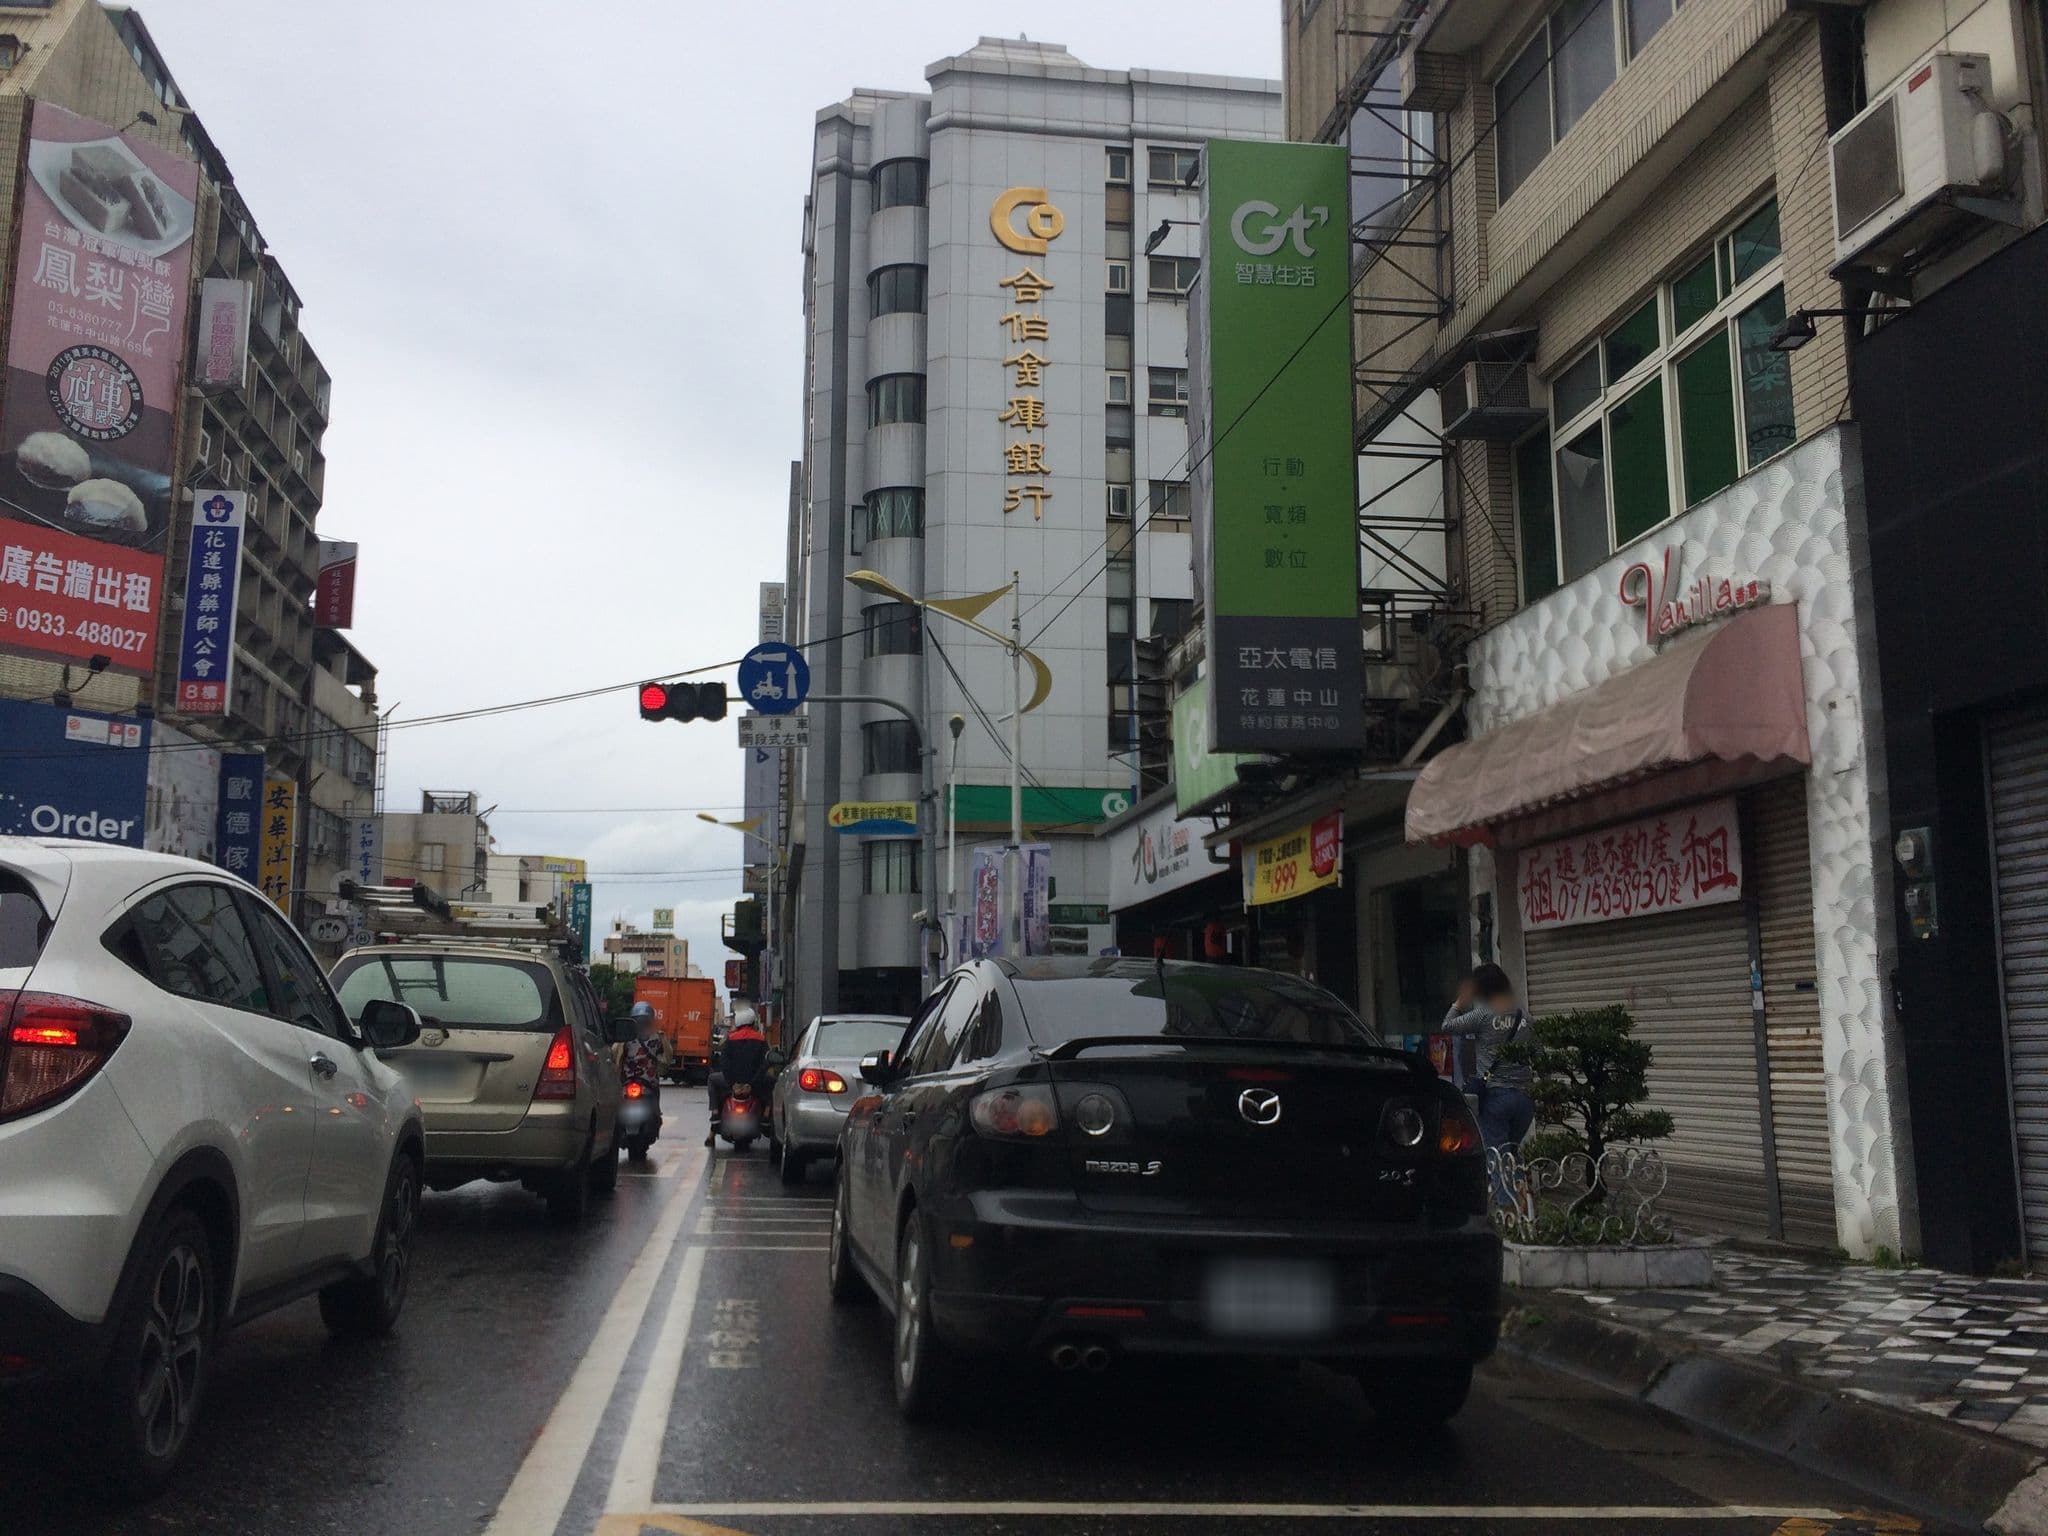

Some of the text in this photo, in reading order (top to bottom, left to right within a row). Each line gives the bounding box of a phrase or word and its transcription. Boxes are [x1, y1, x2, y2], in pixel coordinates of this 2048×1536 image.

[1231, 200, 1328, 257] Gt
[1235, 263, 1315, 287] 智慧生活
[999, 266, 1054, 521] 合作金庫銀行
[1262, 457, 1305, 478] 行動
[1263, 504, 1307, 525] 寬頻
[0, 545, 151, 613] 廣告牆出租
[1263, 547, 1309, 569] 數位
[192, 530, 226, 678] 花蓮縣藥師公會
[1620, 544, 1732, 643] Vanilla
[16, 607, 147, 652] 0933-488027
[1239, 647, 1337, 670] 亞太電信
[1240, 687, 1339, 707] 花蓮中山
[31, 805, 135, 840] Order
[224, 776, 254, 870] 歐德傢
[262, 785, 292, 895] 安華洋行
[359, 823, 374, 887] 仁和堂中
[1680, 815, 1739, 899] 租
[1492, 1015, 1527, 1031] Colle
